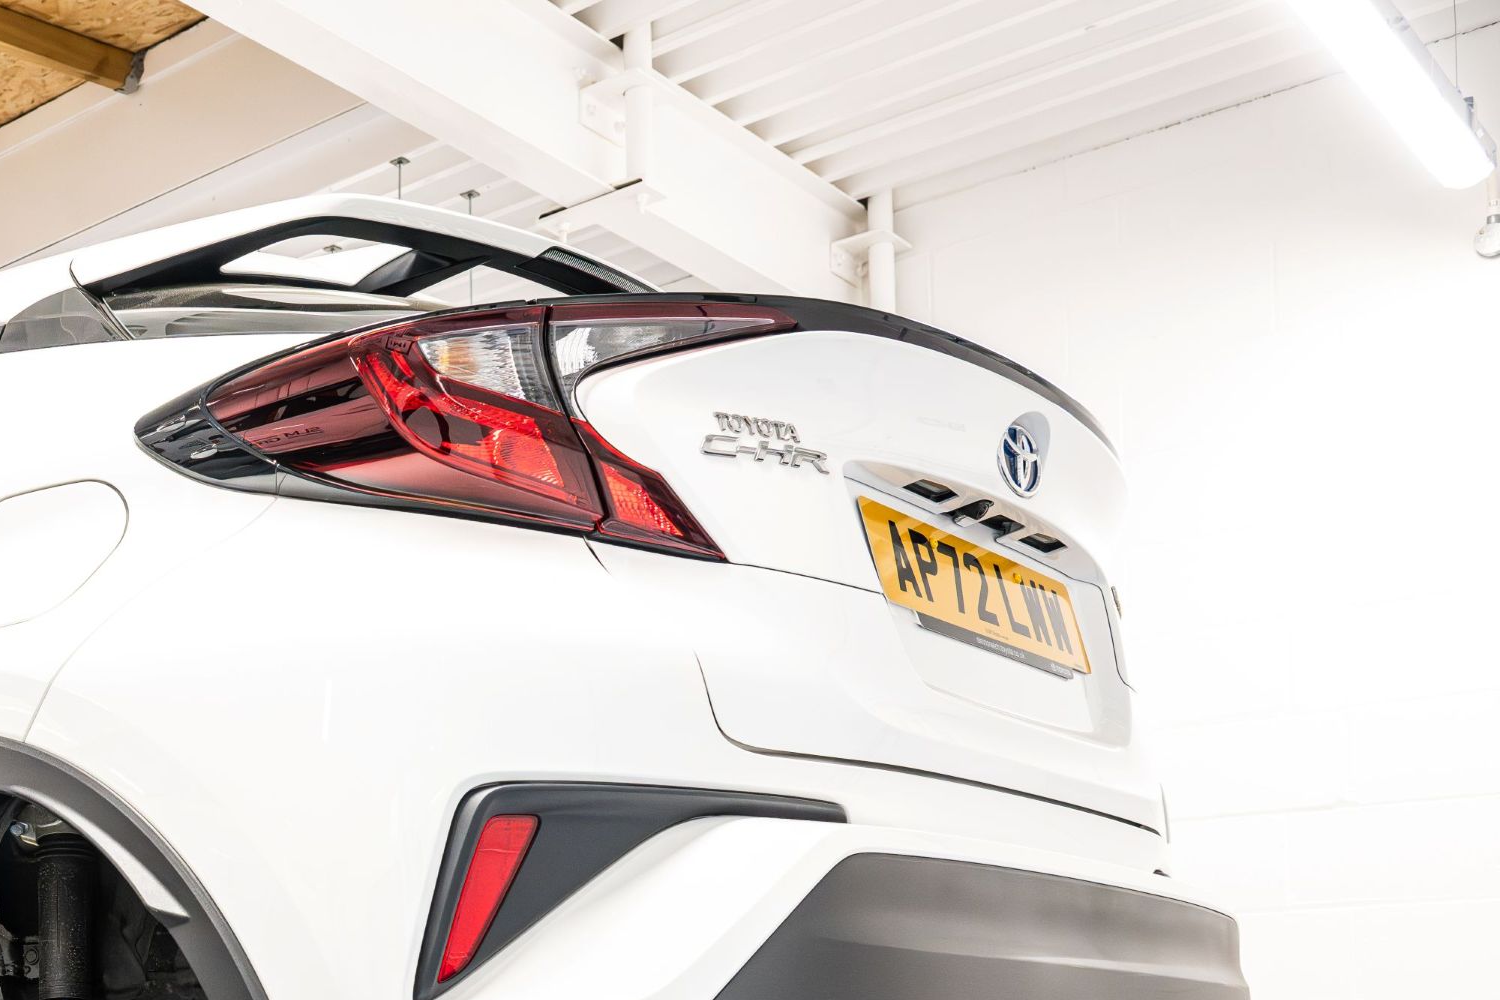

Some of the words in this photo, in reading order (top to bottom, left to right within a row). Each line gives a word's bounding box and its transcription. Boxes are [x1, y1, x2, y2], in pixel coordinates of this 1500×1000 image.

[713, 411, 800, 443] TOYOTA
[700, 434, 830, 475] C-HR
[887, 519, 1000, 627] AP72
